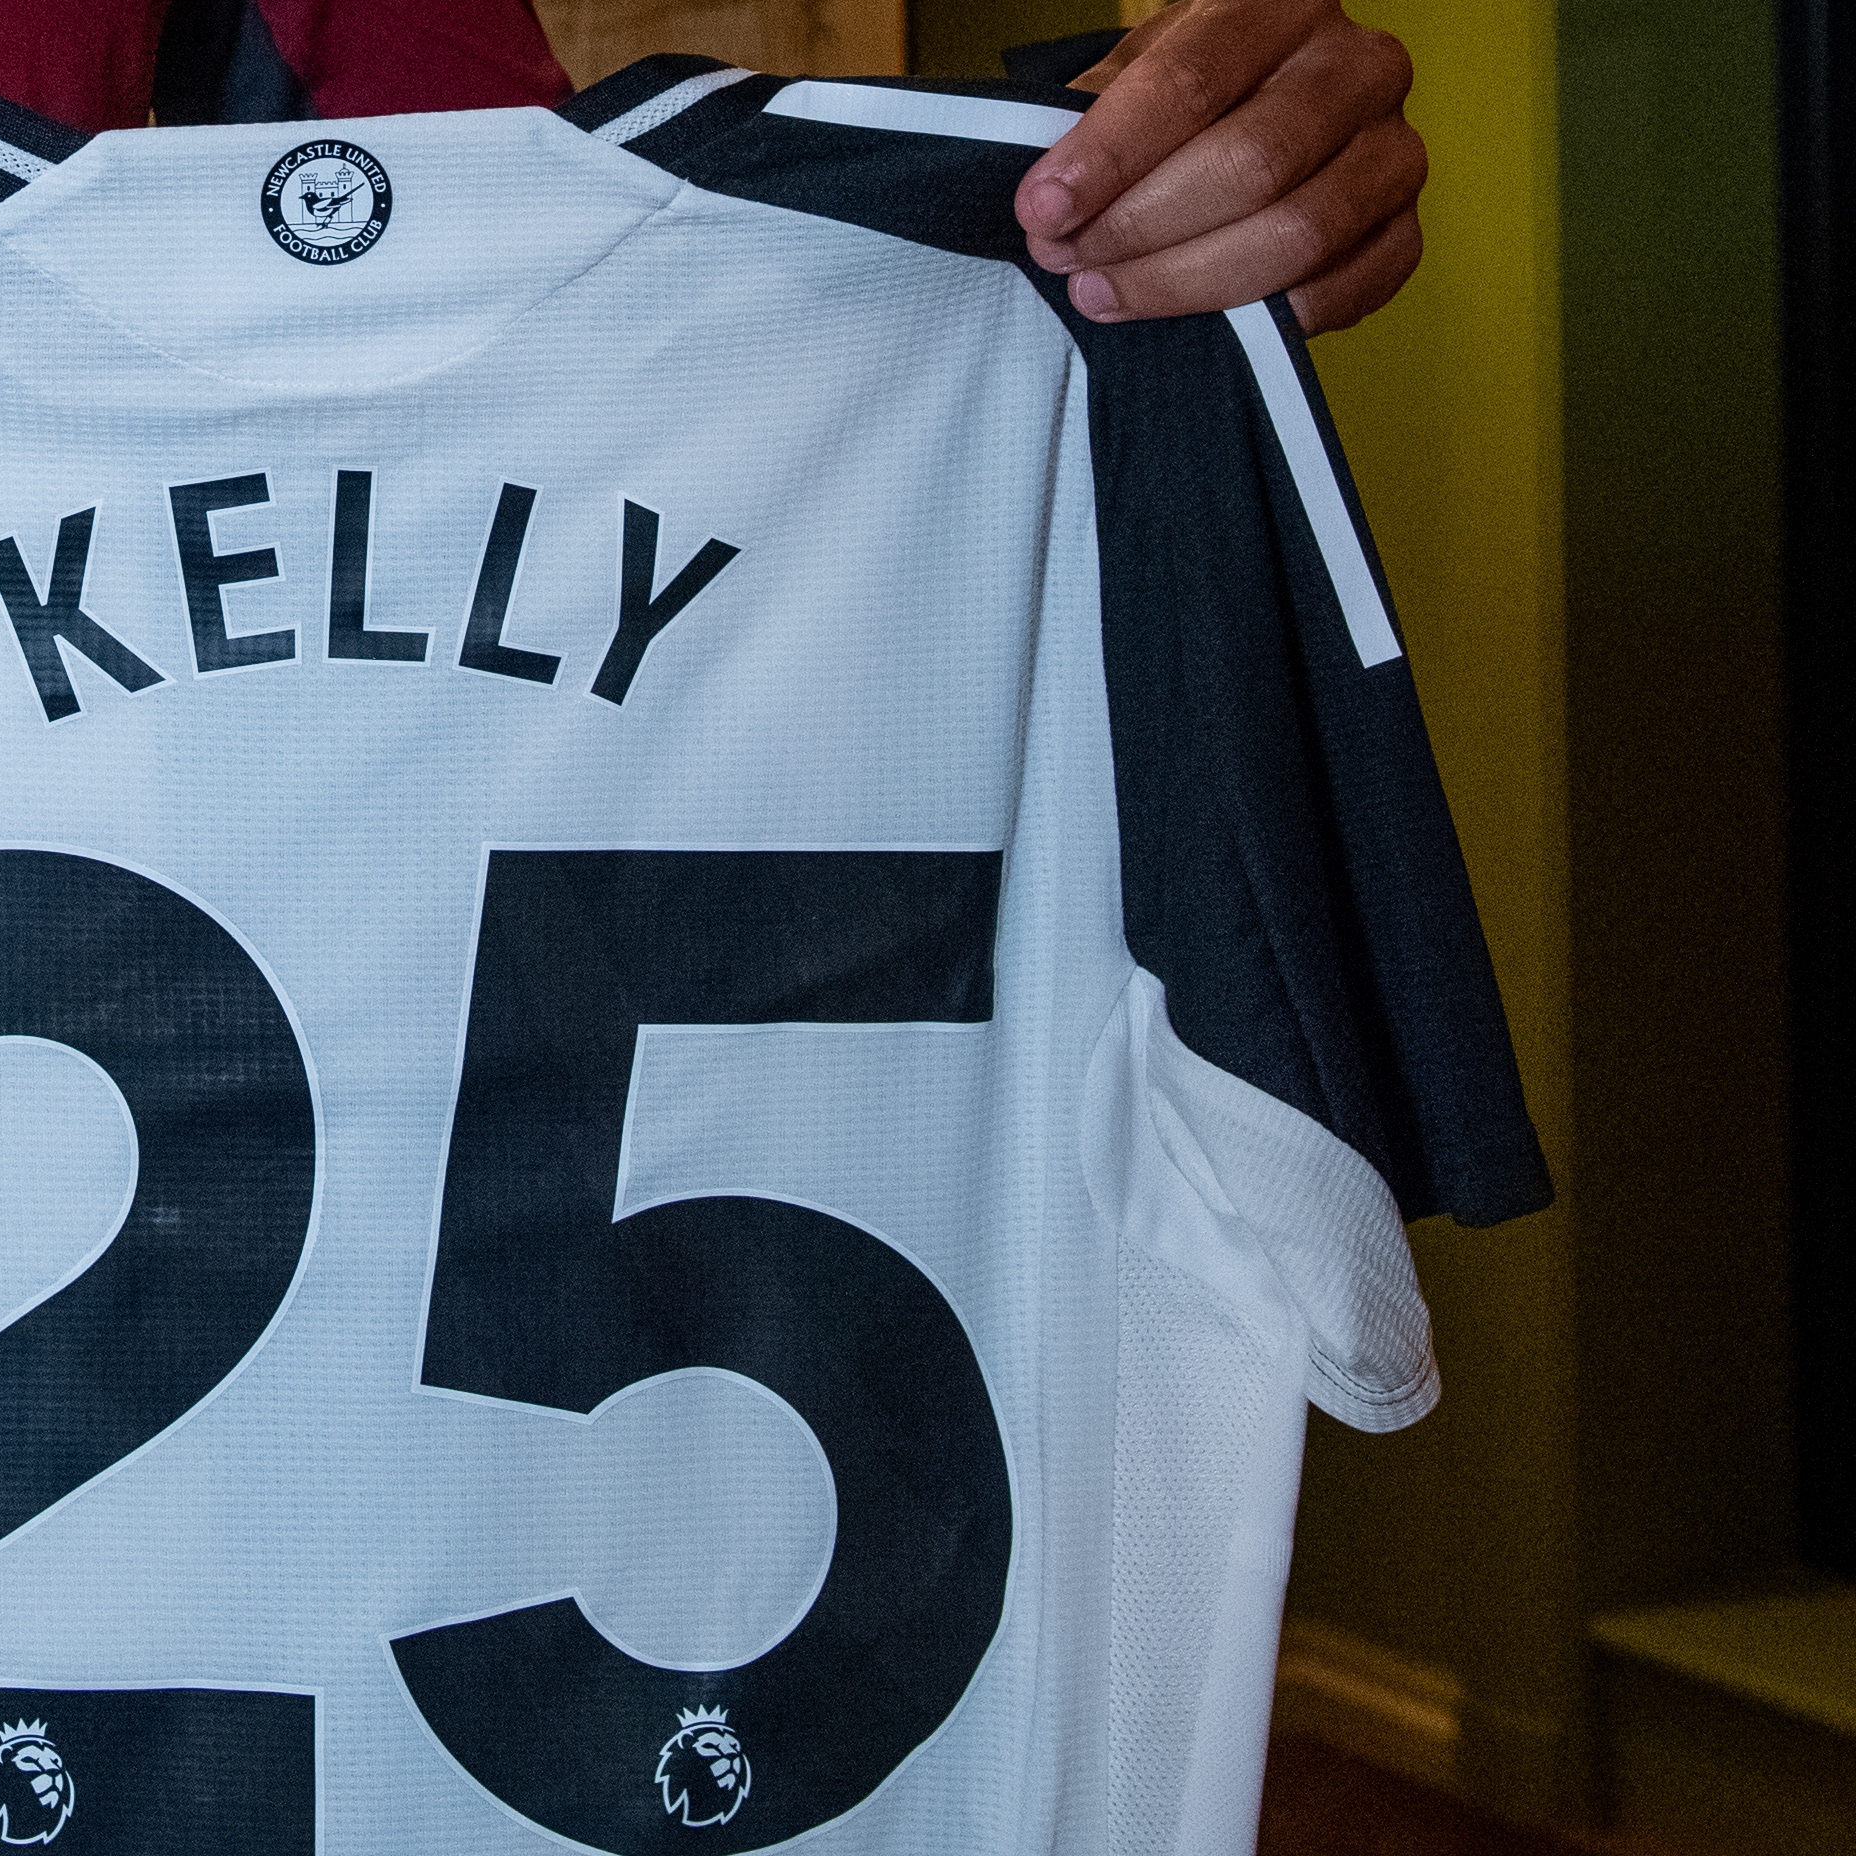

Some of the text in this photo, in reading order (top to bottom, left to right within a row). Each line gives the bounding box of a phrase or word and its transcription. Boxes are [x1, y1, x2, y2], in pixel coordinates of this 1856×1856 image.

[266, 144, 388, 197] NEWCASTLE UNITED
[273, 219, 382, 262] FOOTBALL CLUB
